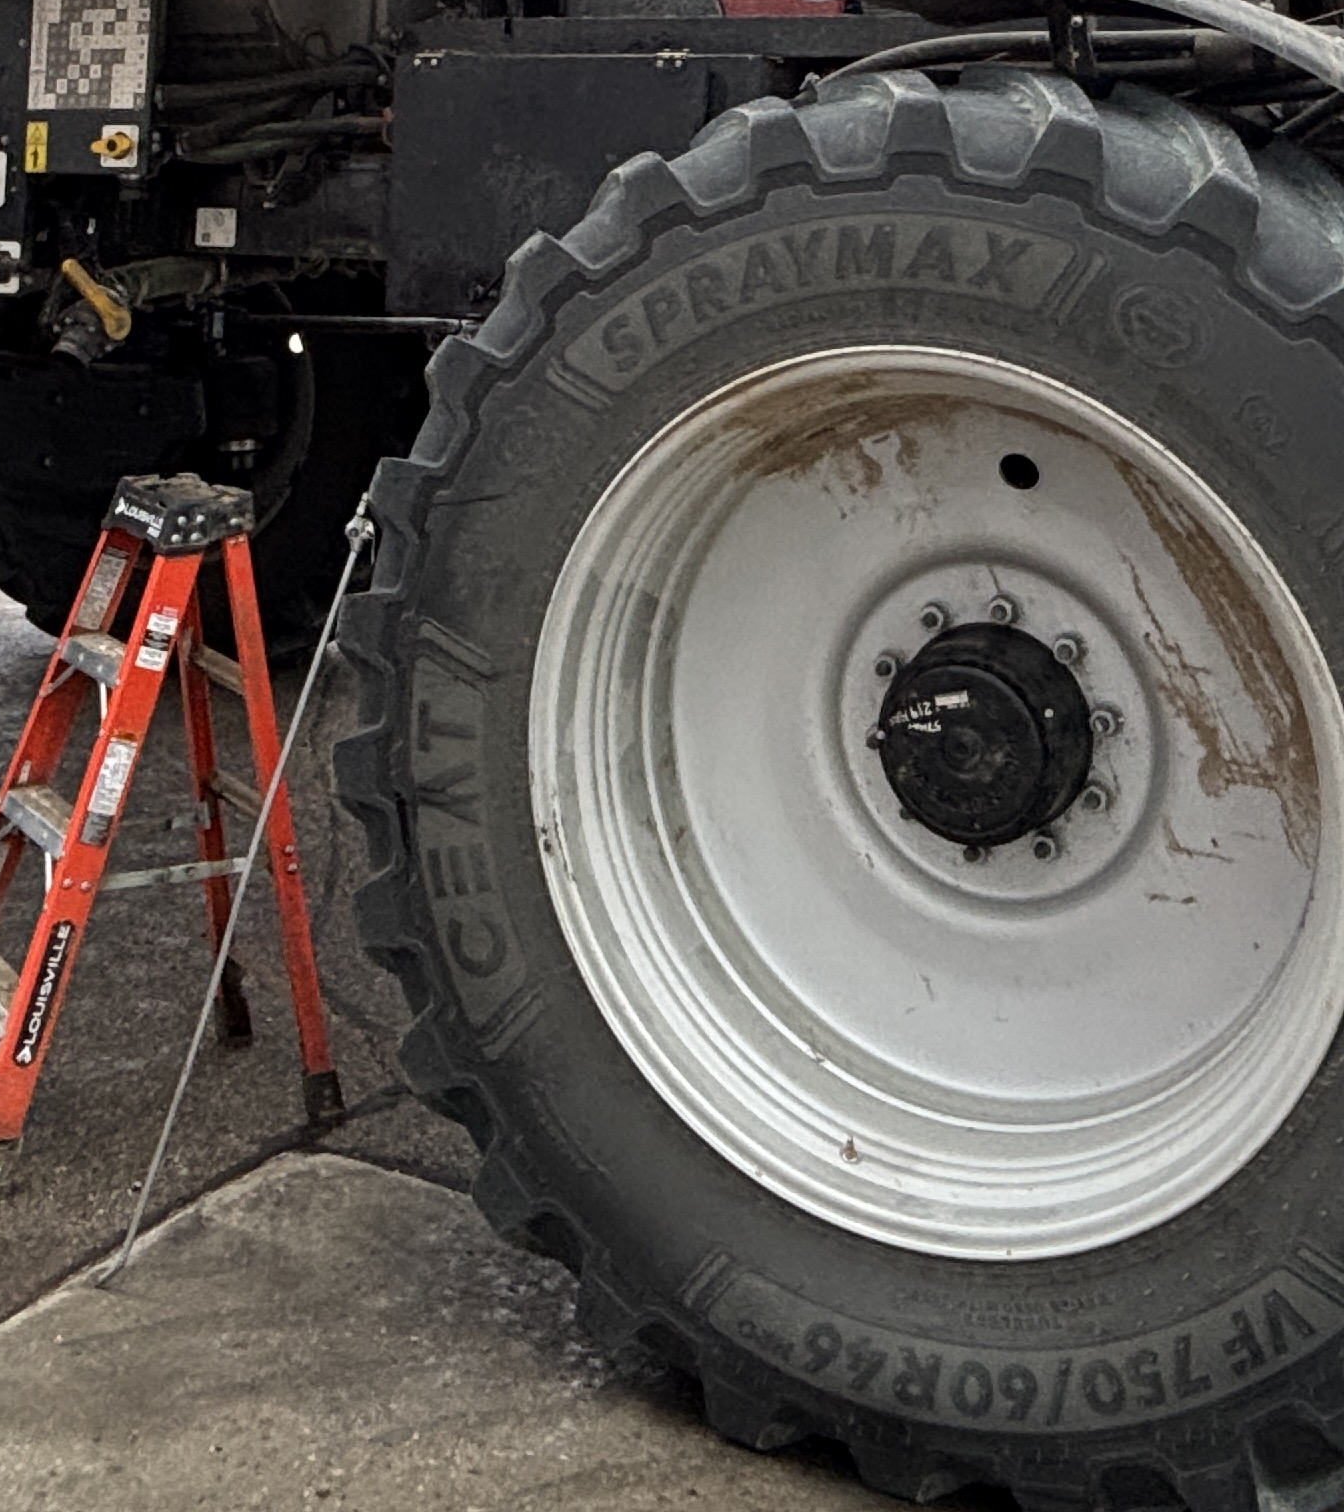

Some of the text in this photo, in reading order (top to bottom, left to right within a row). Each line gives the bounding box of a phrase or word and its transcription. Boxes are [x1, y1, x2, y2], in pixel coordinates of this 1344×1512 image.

[601, 221, 1037, 375] SPRAYMAX
[416, 698, 509, 978] CEAT
[23, 925, 71, 1045] LOUISVILLE
[1221, 1289, 1316, 1377] VF
